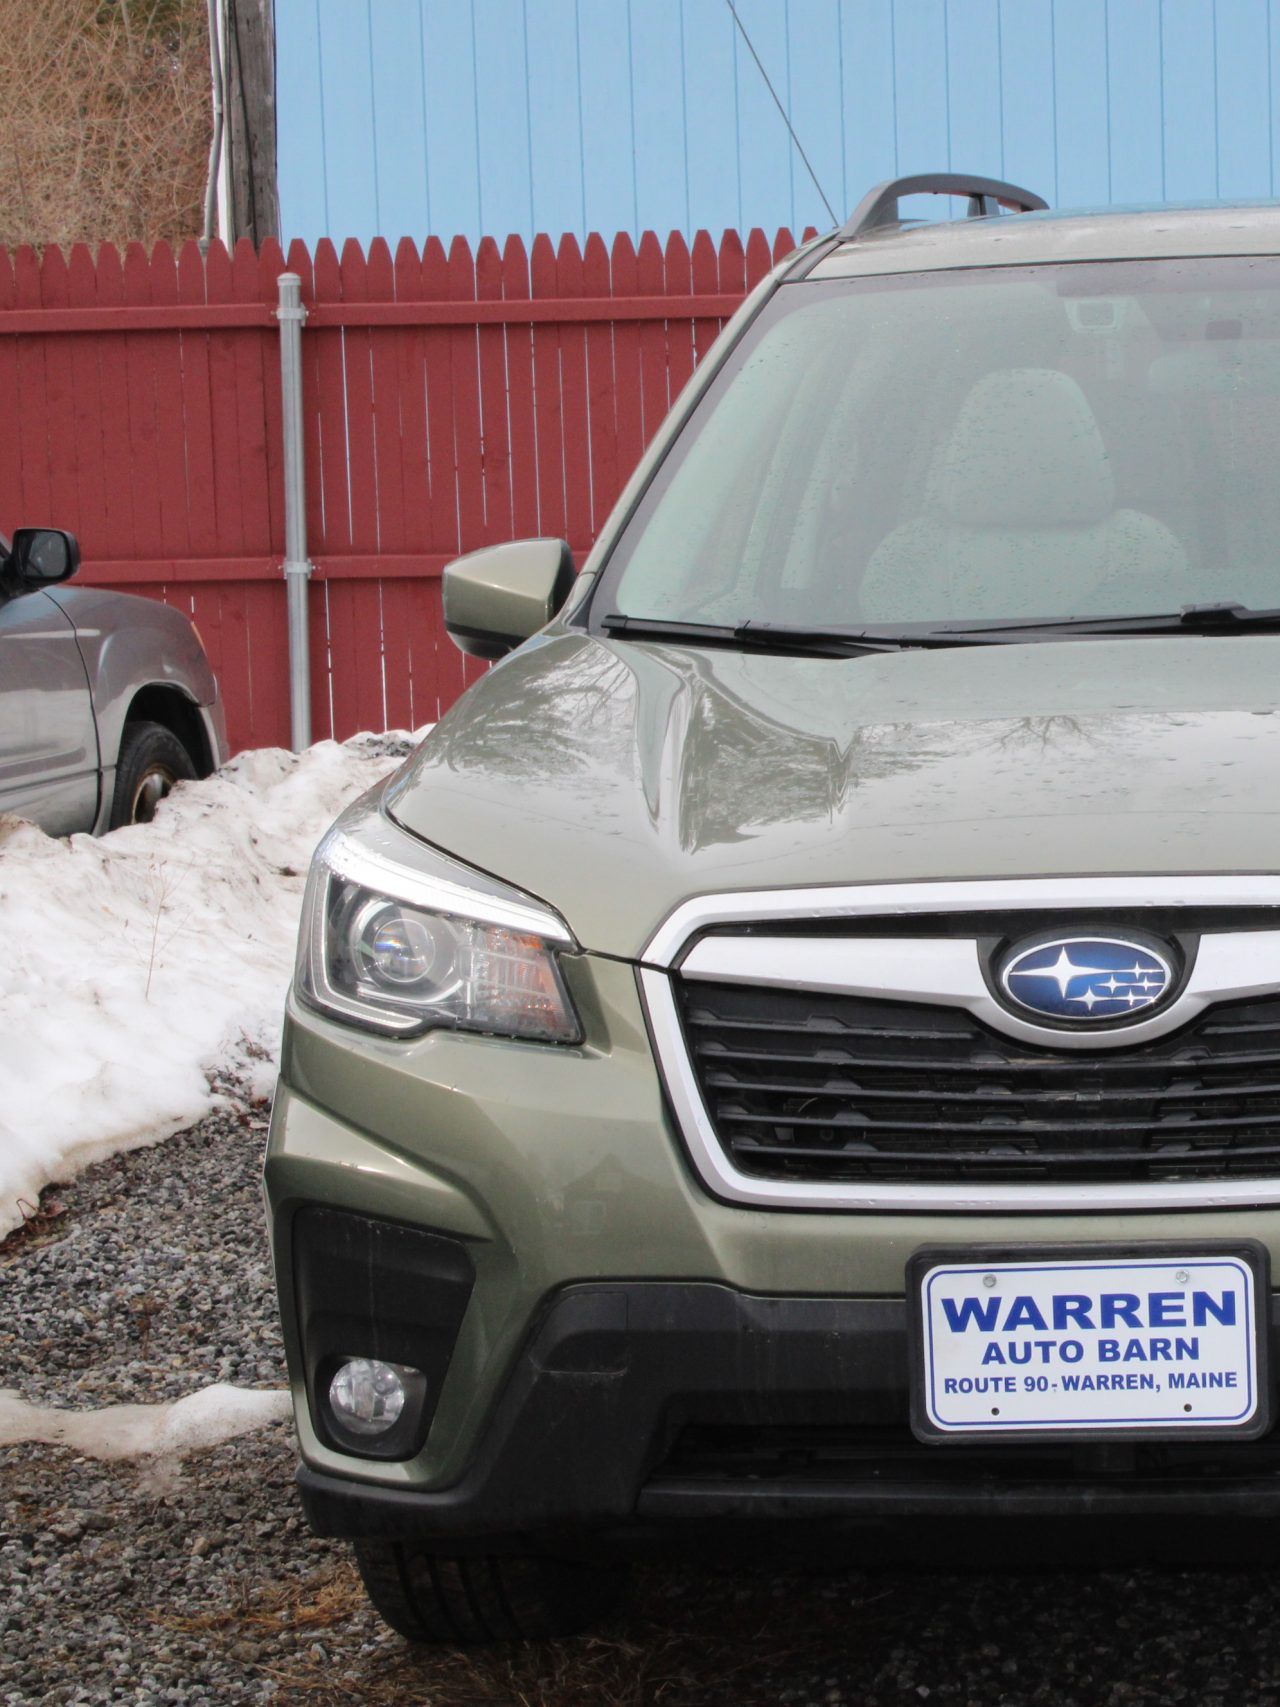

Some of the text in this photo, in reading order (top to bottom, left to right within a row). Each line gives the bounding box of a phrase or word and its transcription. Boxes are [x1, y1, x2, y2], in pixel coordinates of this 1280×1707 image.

[941, 1290, 1238, 1334] WARREN
[981, 1336, 1200, 1366] AUTO BARN
[944, 1377, 1018, 1394] ROUTE
[1168, 1371, 1238, 1390] MAINE
